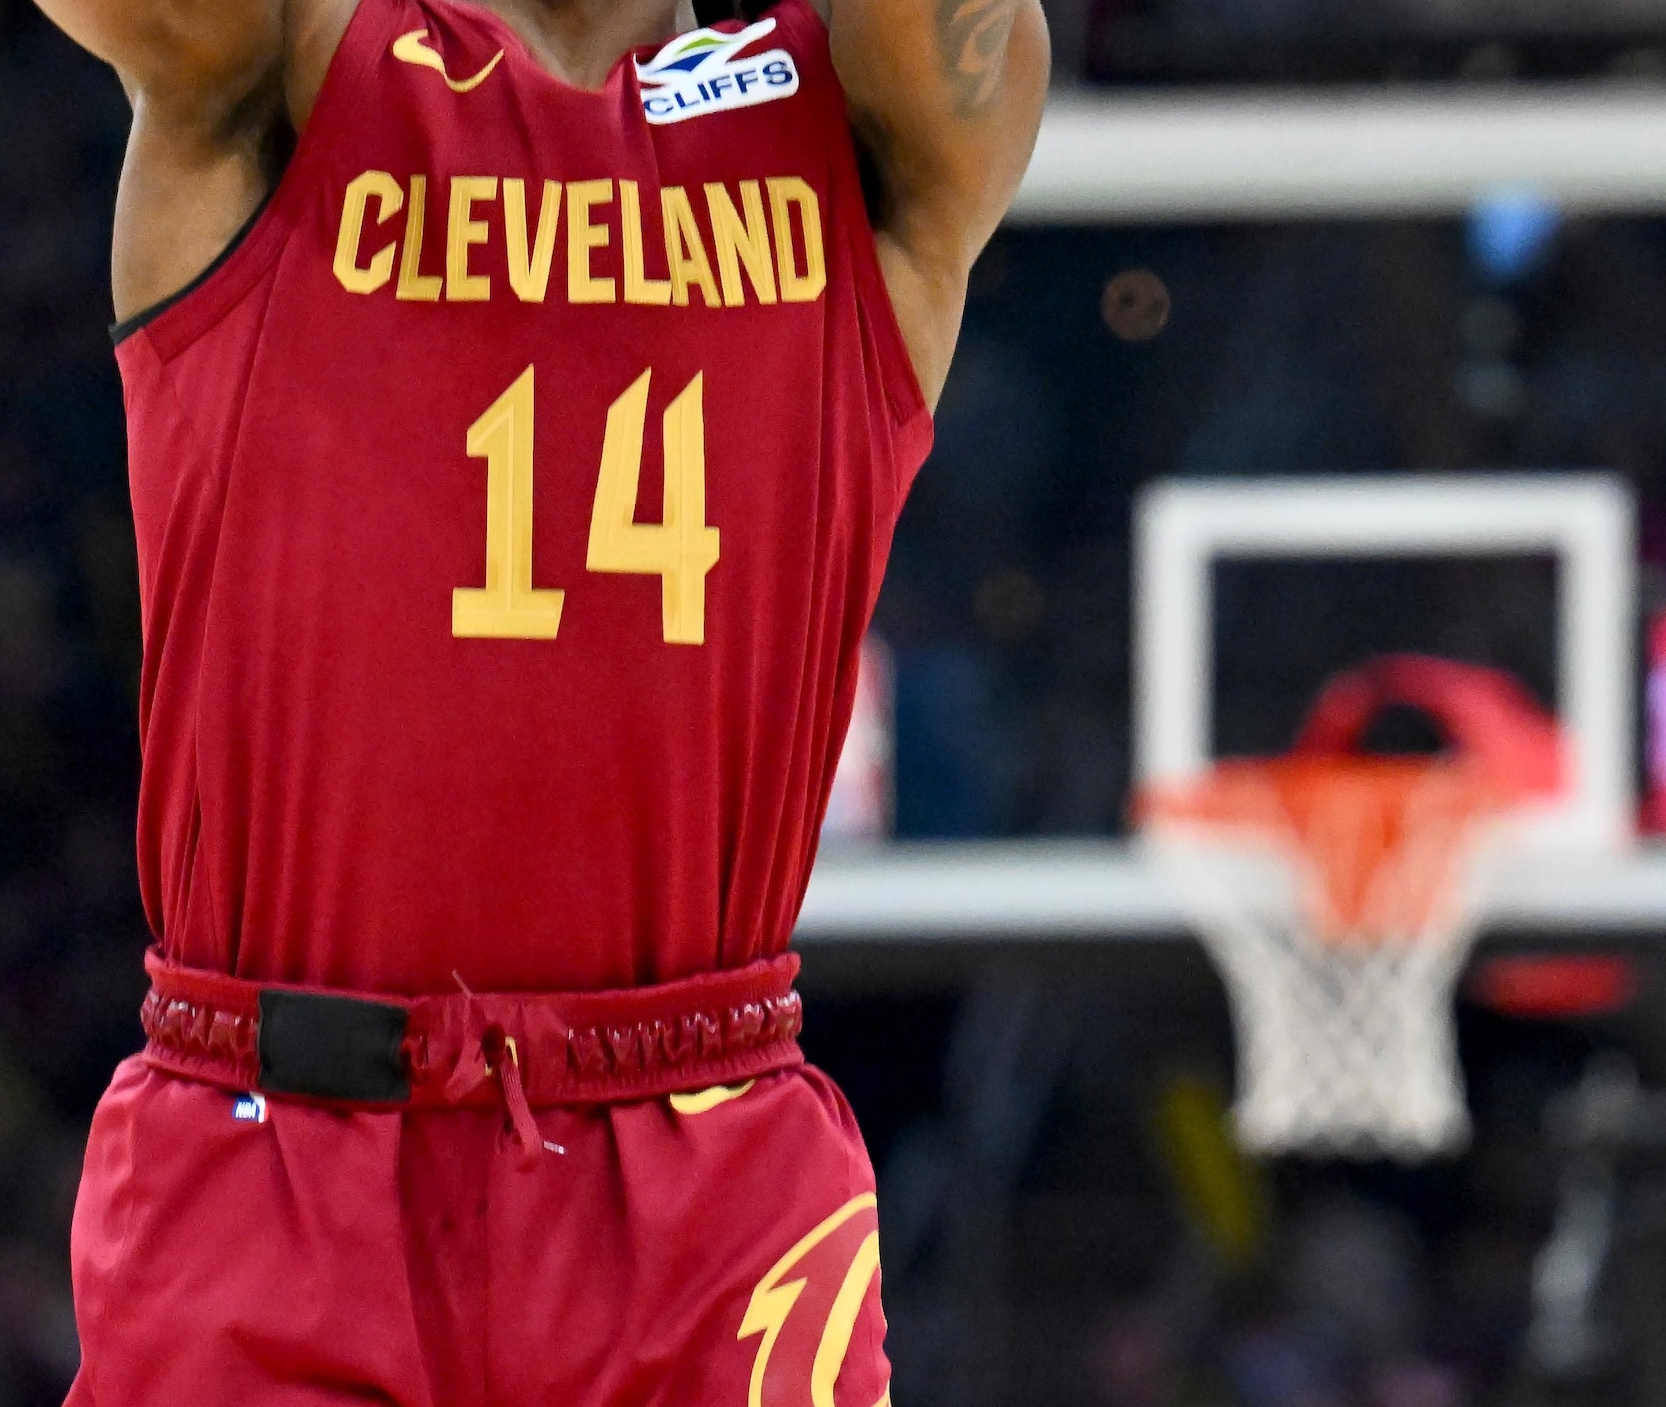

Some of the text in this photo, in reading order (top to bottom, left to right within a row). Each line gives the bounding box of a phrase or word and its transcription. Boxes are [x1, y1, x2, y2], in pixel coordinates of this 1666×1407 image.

[644, 60, 793, 115] CLIFFS
[333, 169, 826, 308] CLEVELAND
[451, 362, 721, 646] 14
